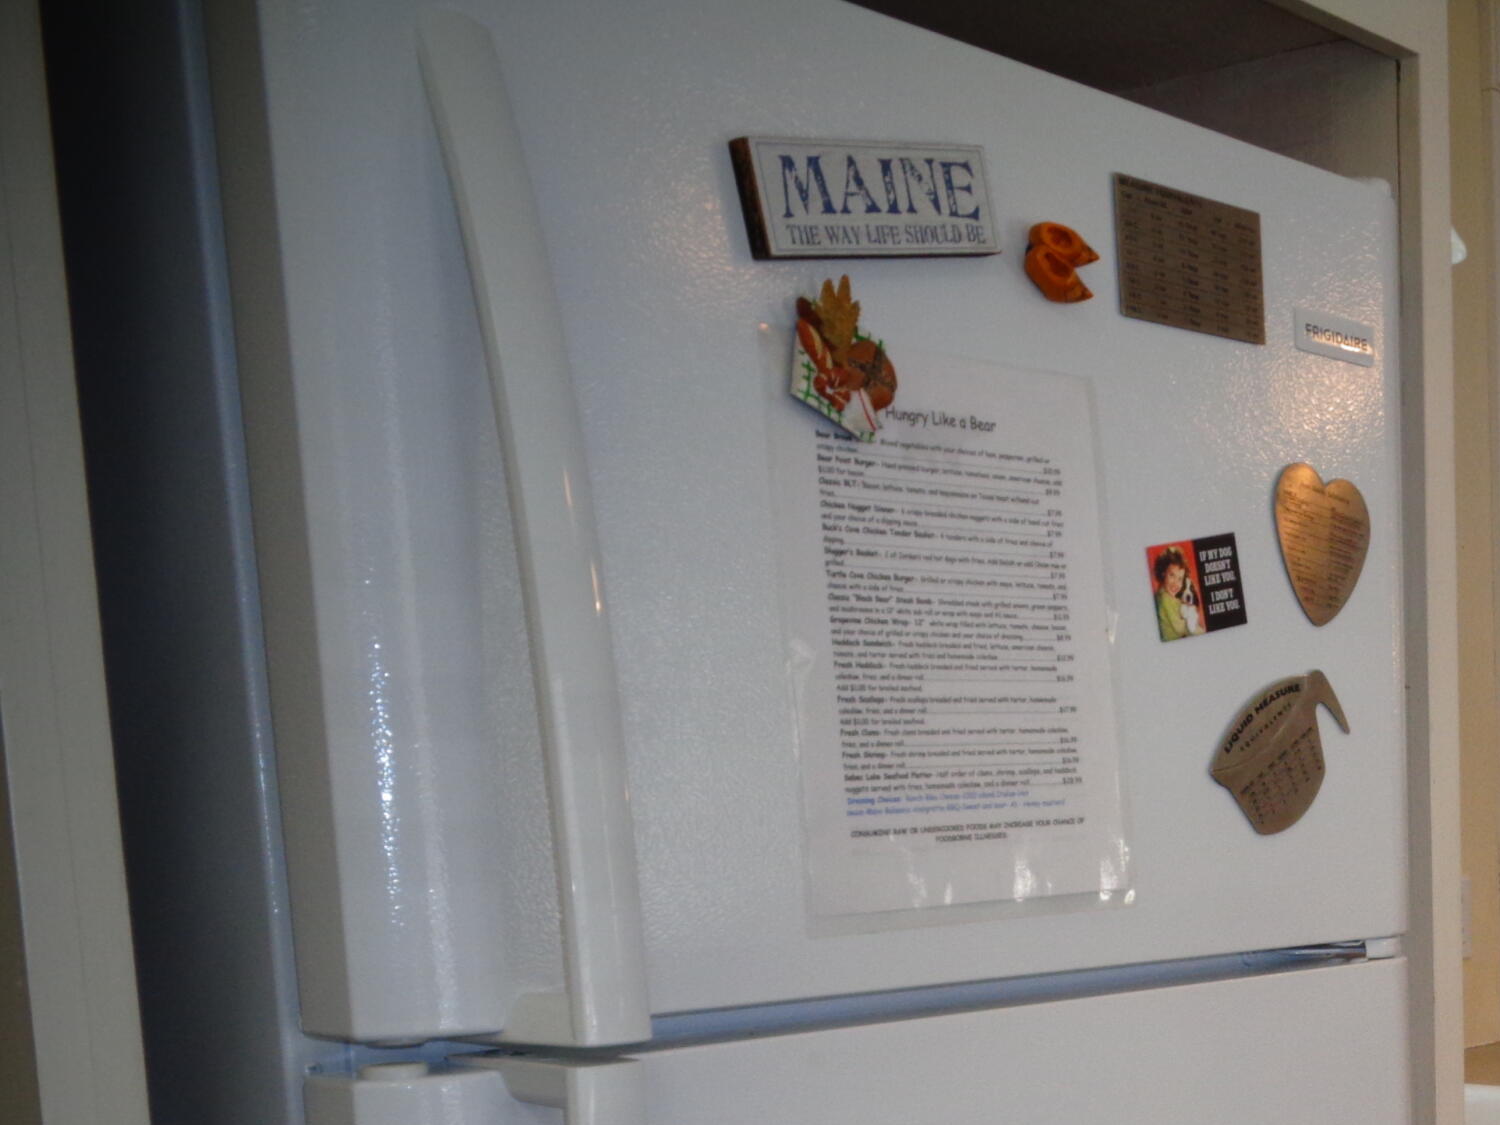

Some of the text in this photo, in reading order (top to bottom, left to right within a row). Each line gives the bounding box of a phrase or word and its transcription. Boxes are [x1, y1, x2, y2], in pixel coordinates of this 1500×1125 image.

[778, 154, 980, 221] MAINE
[786, 223, 987, 246] THE WAY LIFE SHOULD BE
[1304, 322, 1368, 352] FRIGIDAIRE
[884, 405, 997, 433] Hungry Like a Bear
[1199, 546, 1233, 562] IF MY DOG
[1204, 558, 1231, 573] DOESN'T
[1204, 573, 1220, 586] LIKE
[1208, 602, 1225, 615] LIKE
[1223, 683, 1301, 754] LIQUID MEASURE
